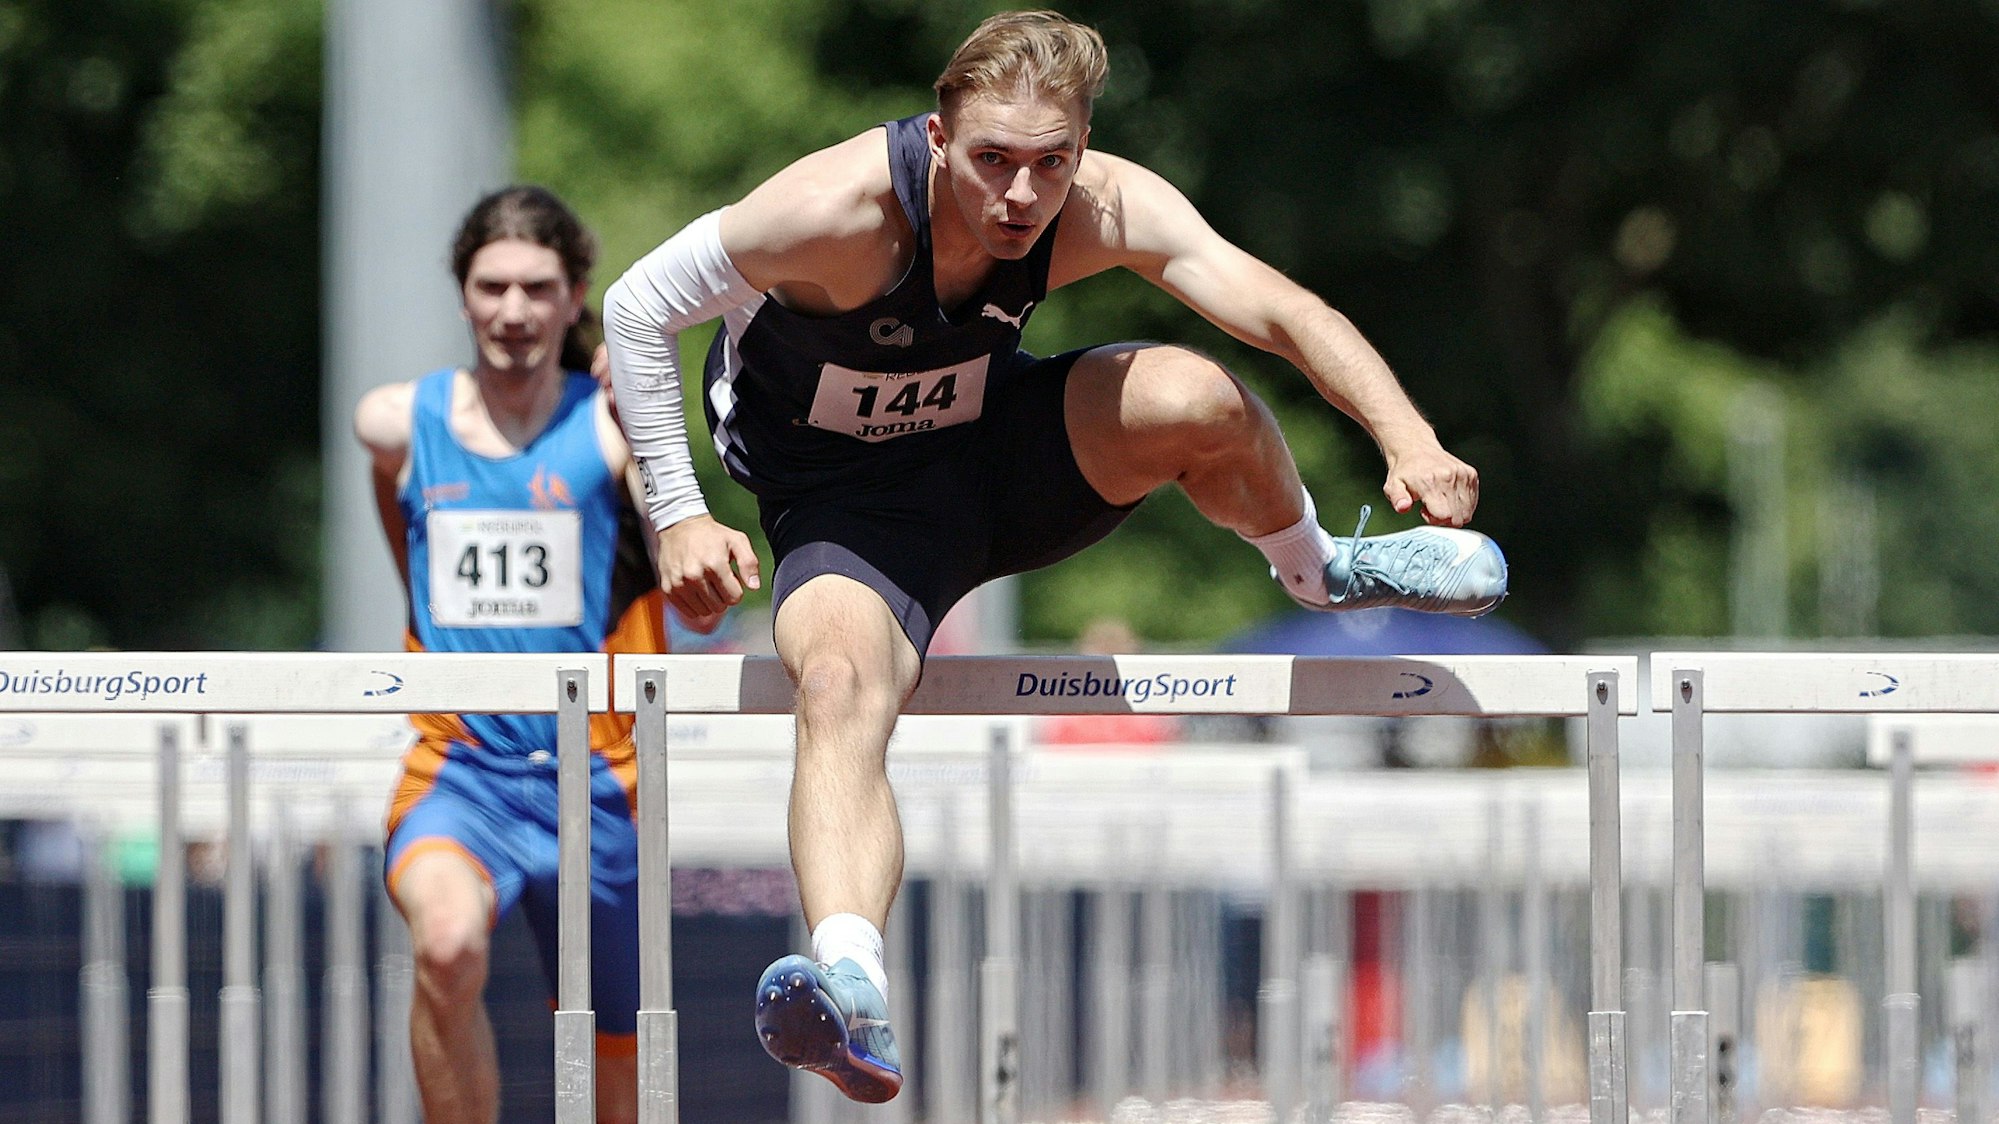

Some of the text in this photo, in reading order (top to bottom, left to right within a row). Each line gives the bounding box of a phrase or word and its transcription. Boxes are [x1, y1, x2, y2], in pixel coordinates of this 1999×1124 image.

[852, 373, 957, 418] 144
[855, 419, 936, 437] Joma
[457, 543, 549, 588] 413
[1016, 672, 1237, 703] DuisburgSport
